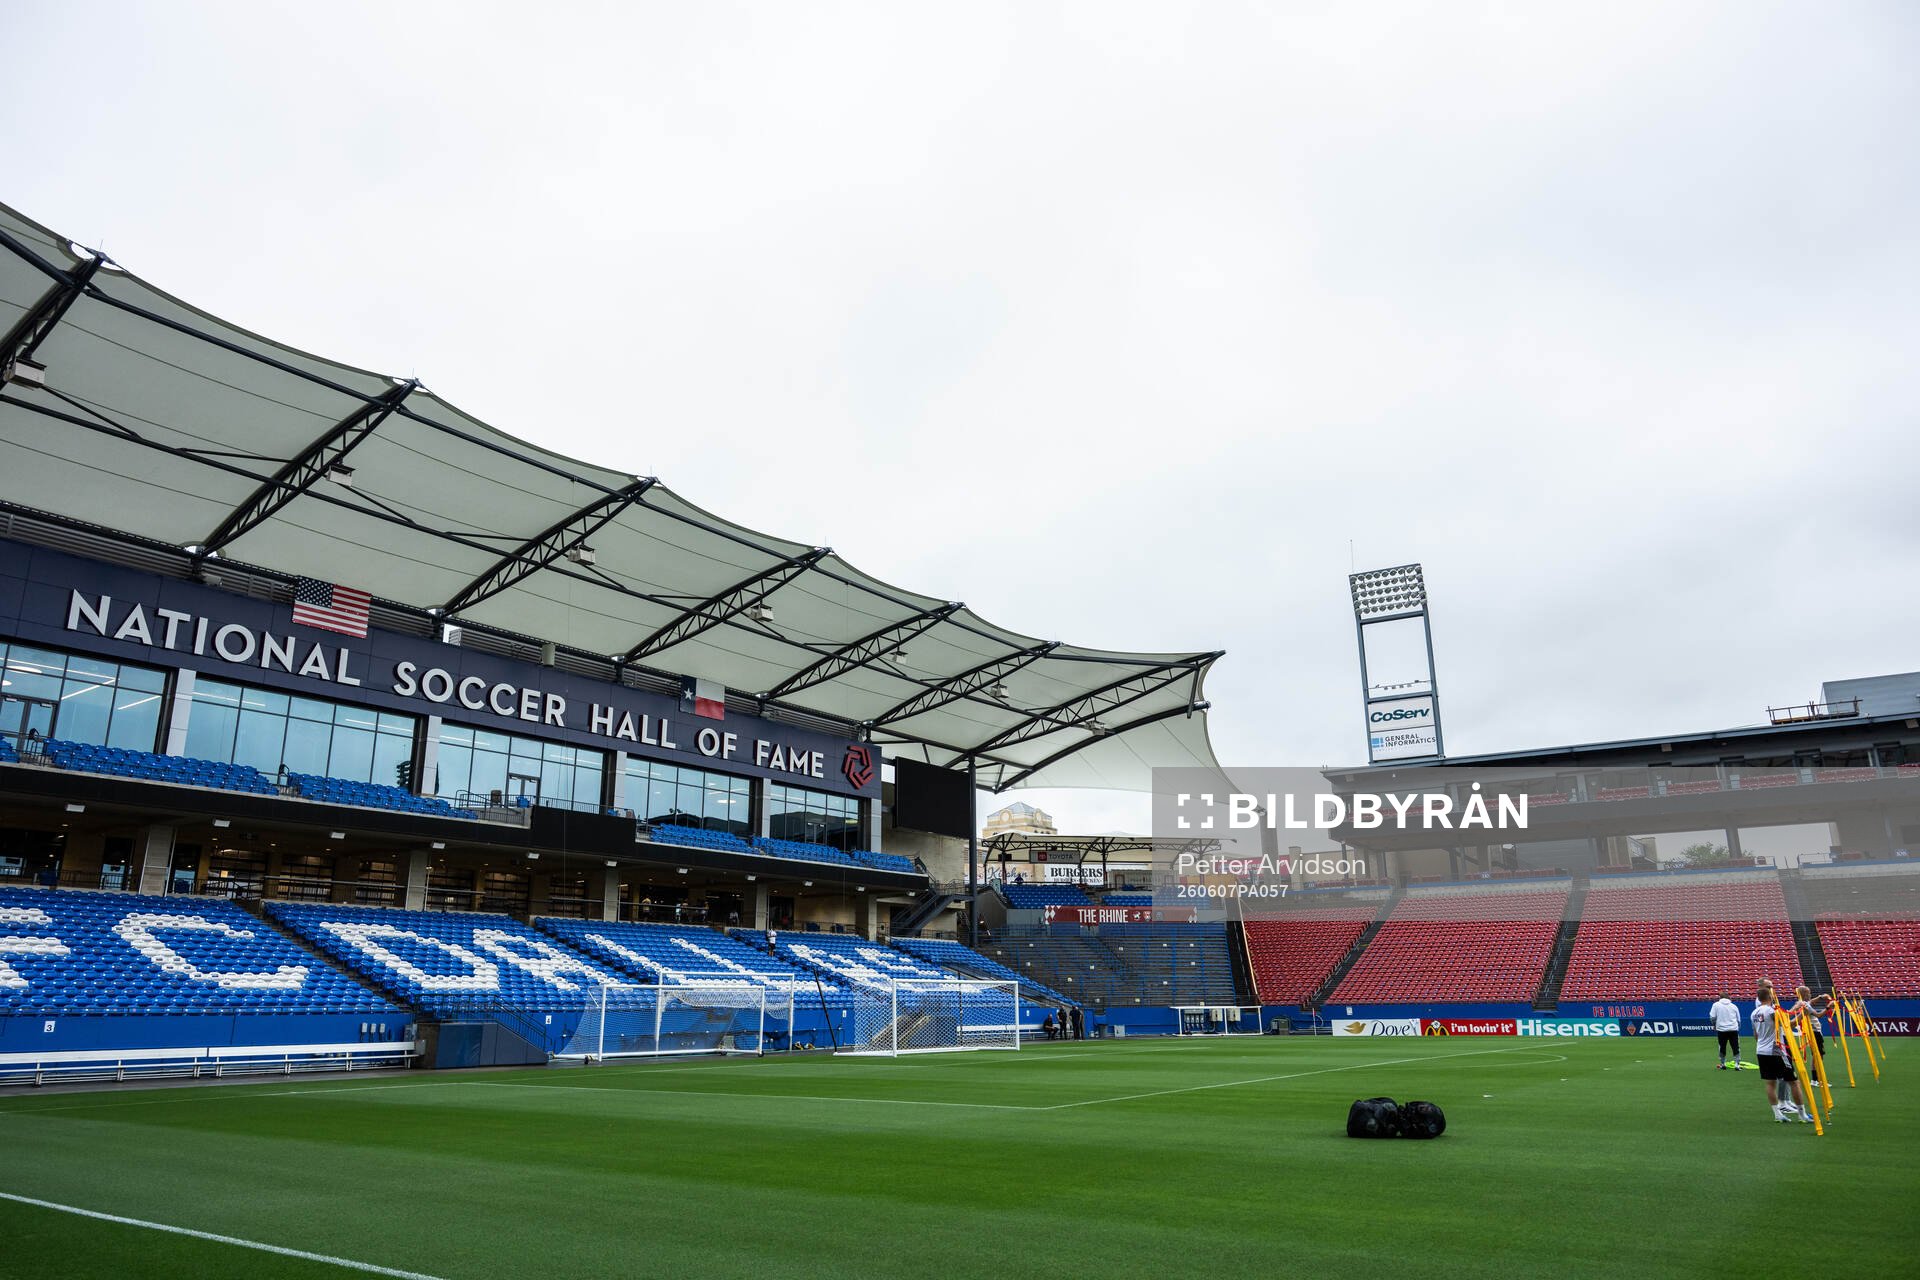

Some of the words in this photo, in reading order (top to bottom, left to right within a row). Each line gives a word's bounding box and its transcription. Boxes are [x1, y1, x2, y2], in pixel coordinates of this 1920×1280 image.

[66, 589, 361, 687] NATIONAL
[392, 661, 567, 727] SOCCER
[591, 703, 676, 749] HALL
[698, 728, 738, 760] OF
[755, 740, 825, 779] FAME
[1371, 708, 1430, 723] CoServ
[1385, 733, 1419, 742] GENERAL
[1385, 737, 1436, 747] INFORMATICS
[1050, 867, 1103, 878] BURGERS
[1077, 909, 1097, 923] THE
[1099, 909, 1128, 923] RHINE
[1593, 1006, 1604, 1017] FC
[1608, 1006, 1645, 1017] DALLAS
[46, 1024, 53, 1032] 3
[1371, 1020, 1410, 1036] Dove
[1451, 1023, 1468, 1033] i'm
[1469, 1023, 1499, 1033] lovin'
[1516, 1019, 1621, 1036] Hisense
[1639, 1022, 1674, 1034] ADI
